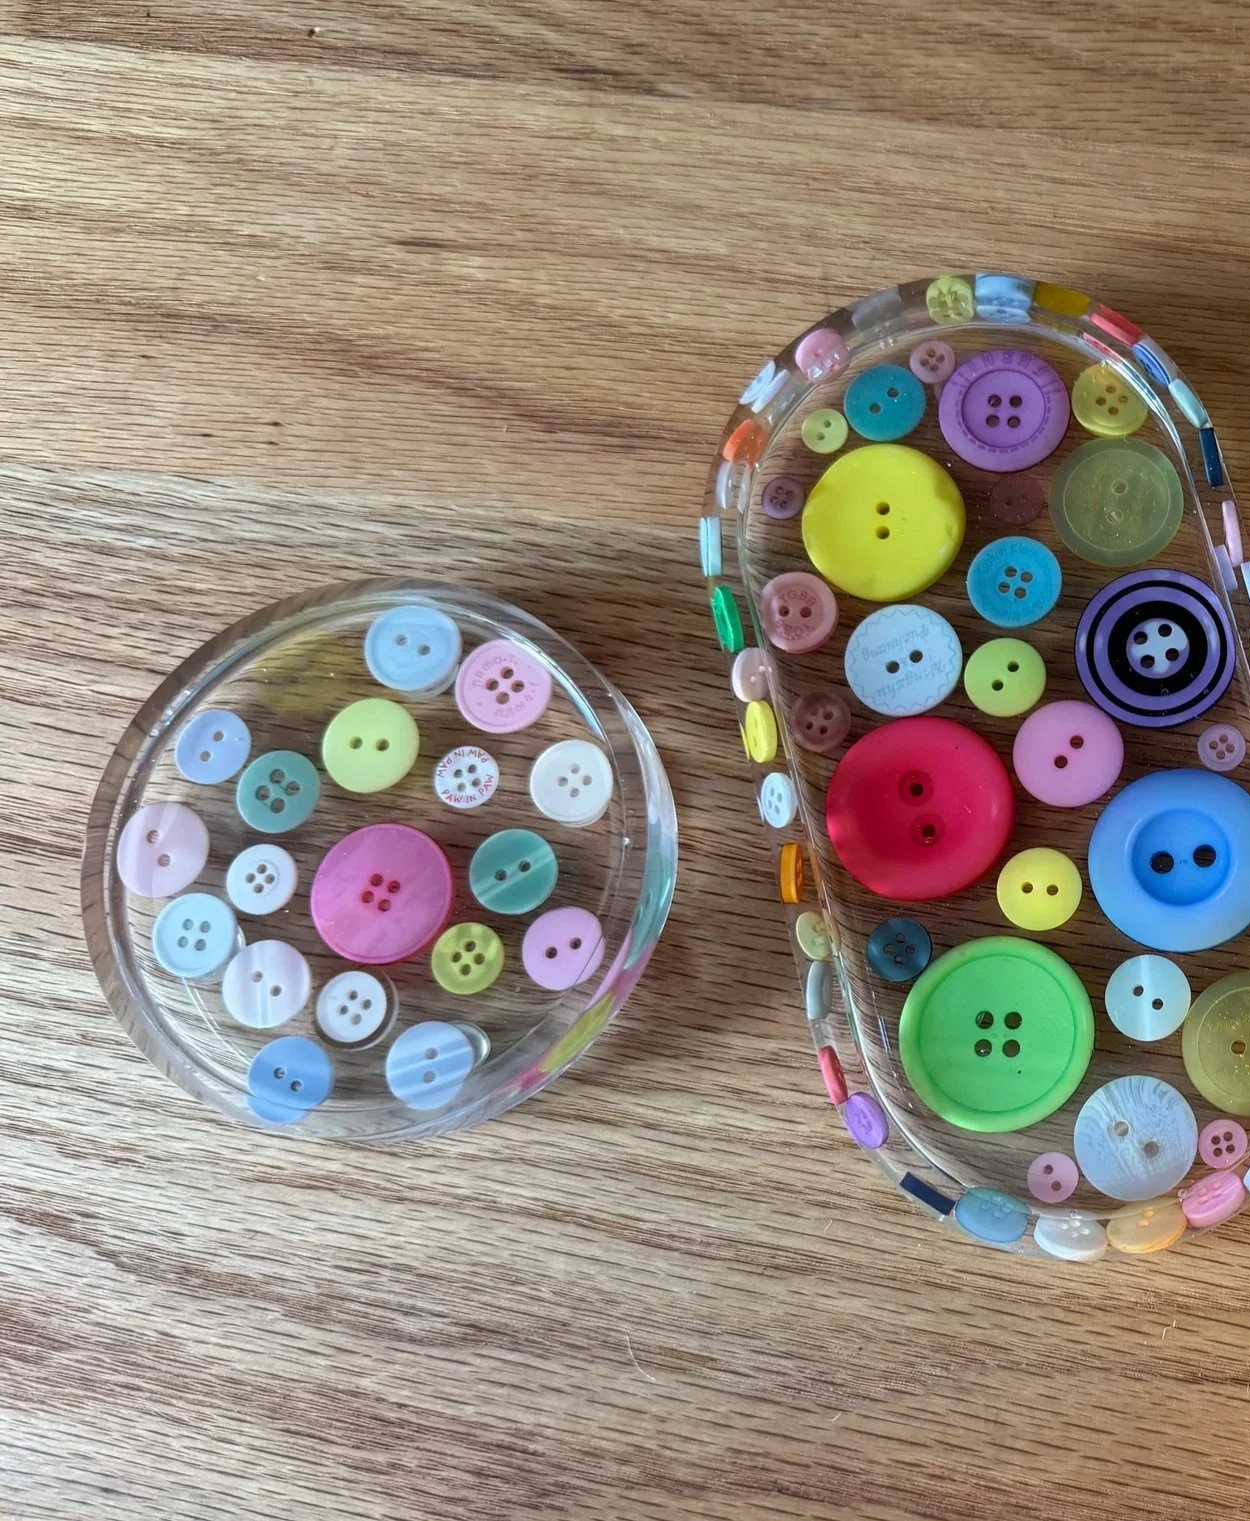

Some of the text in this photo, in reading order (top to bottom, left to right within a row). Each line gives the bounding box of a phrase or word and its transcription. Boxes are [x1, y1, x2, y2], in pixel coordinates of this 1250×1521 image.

[436, 748, 489, 778] PAW IN PAW
[441, 774, 494, 804] PAW IN PAW
